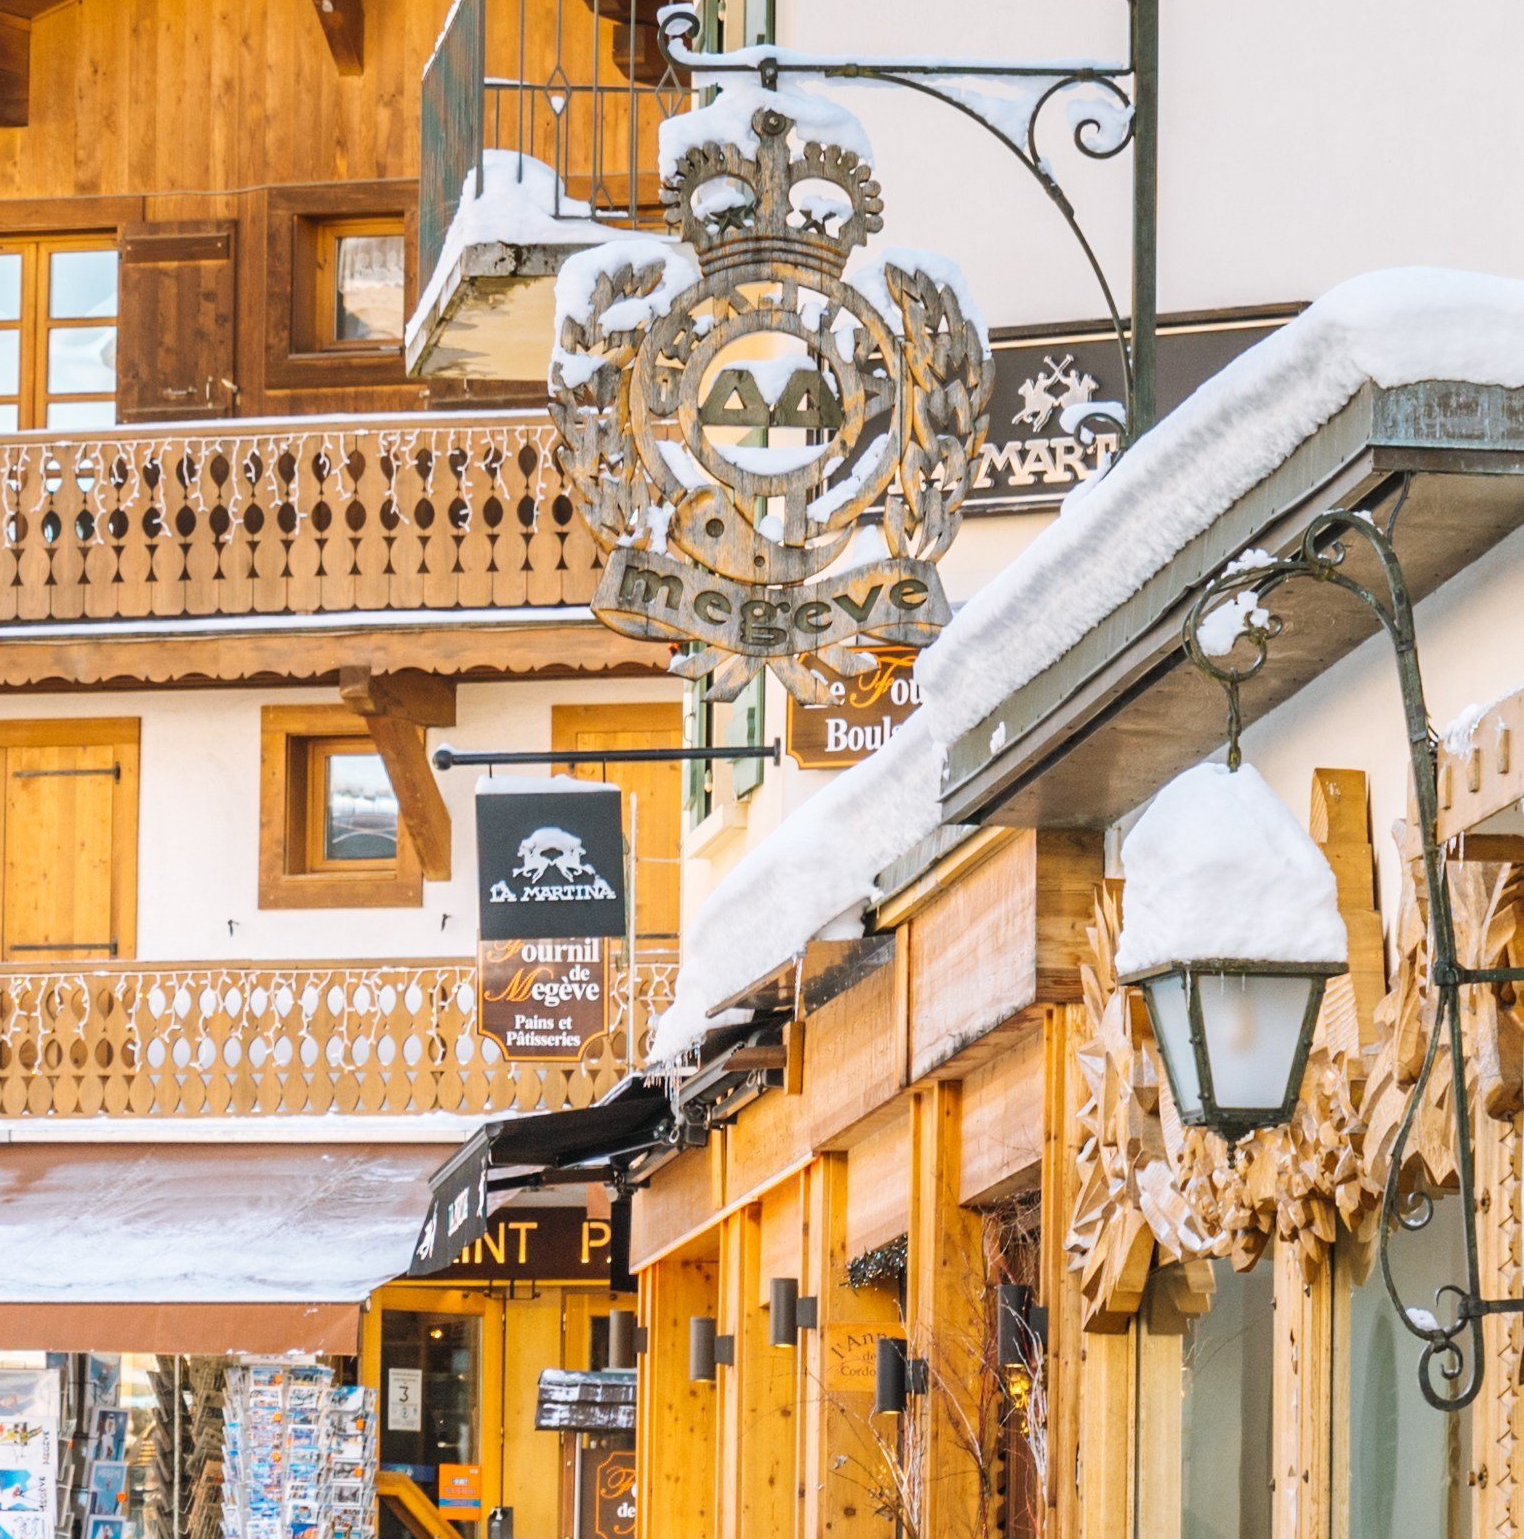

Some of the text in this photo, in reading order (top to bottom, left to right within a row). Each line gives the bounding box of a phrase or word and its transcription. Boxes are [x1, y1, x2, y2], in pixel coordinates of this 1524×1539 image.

[825, 716, 902, 752] Boul
[490, 881, 616, 902] LA MARTINA
[487, 938, 600, 963] Fournil
[569, 964, 590, 981] de
[484, 967, 600, 1007] Megève
[514, 1014, 573, 1030] Pains et
[506, 1031, 582, 1046] Pâtisseries
[398, 1385, 409, 1402] 3
